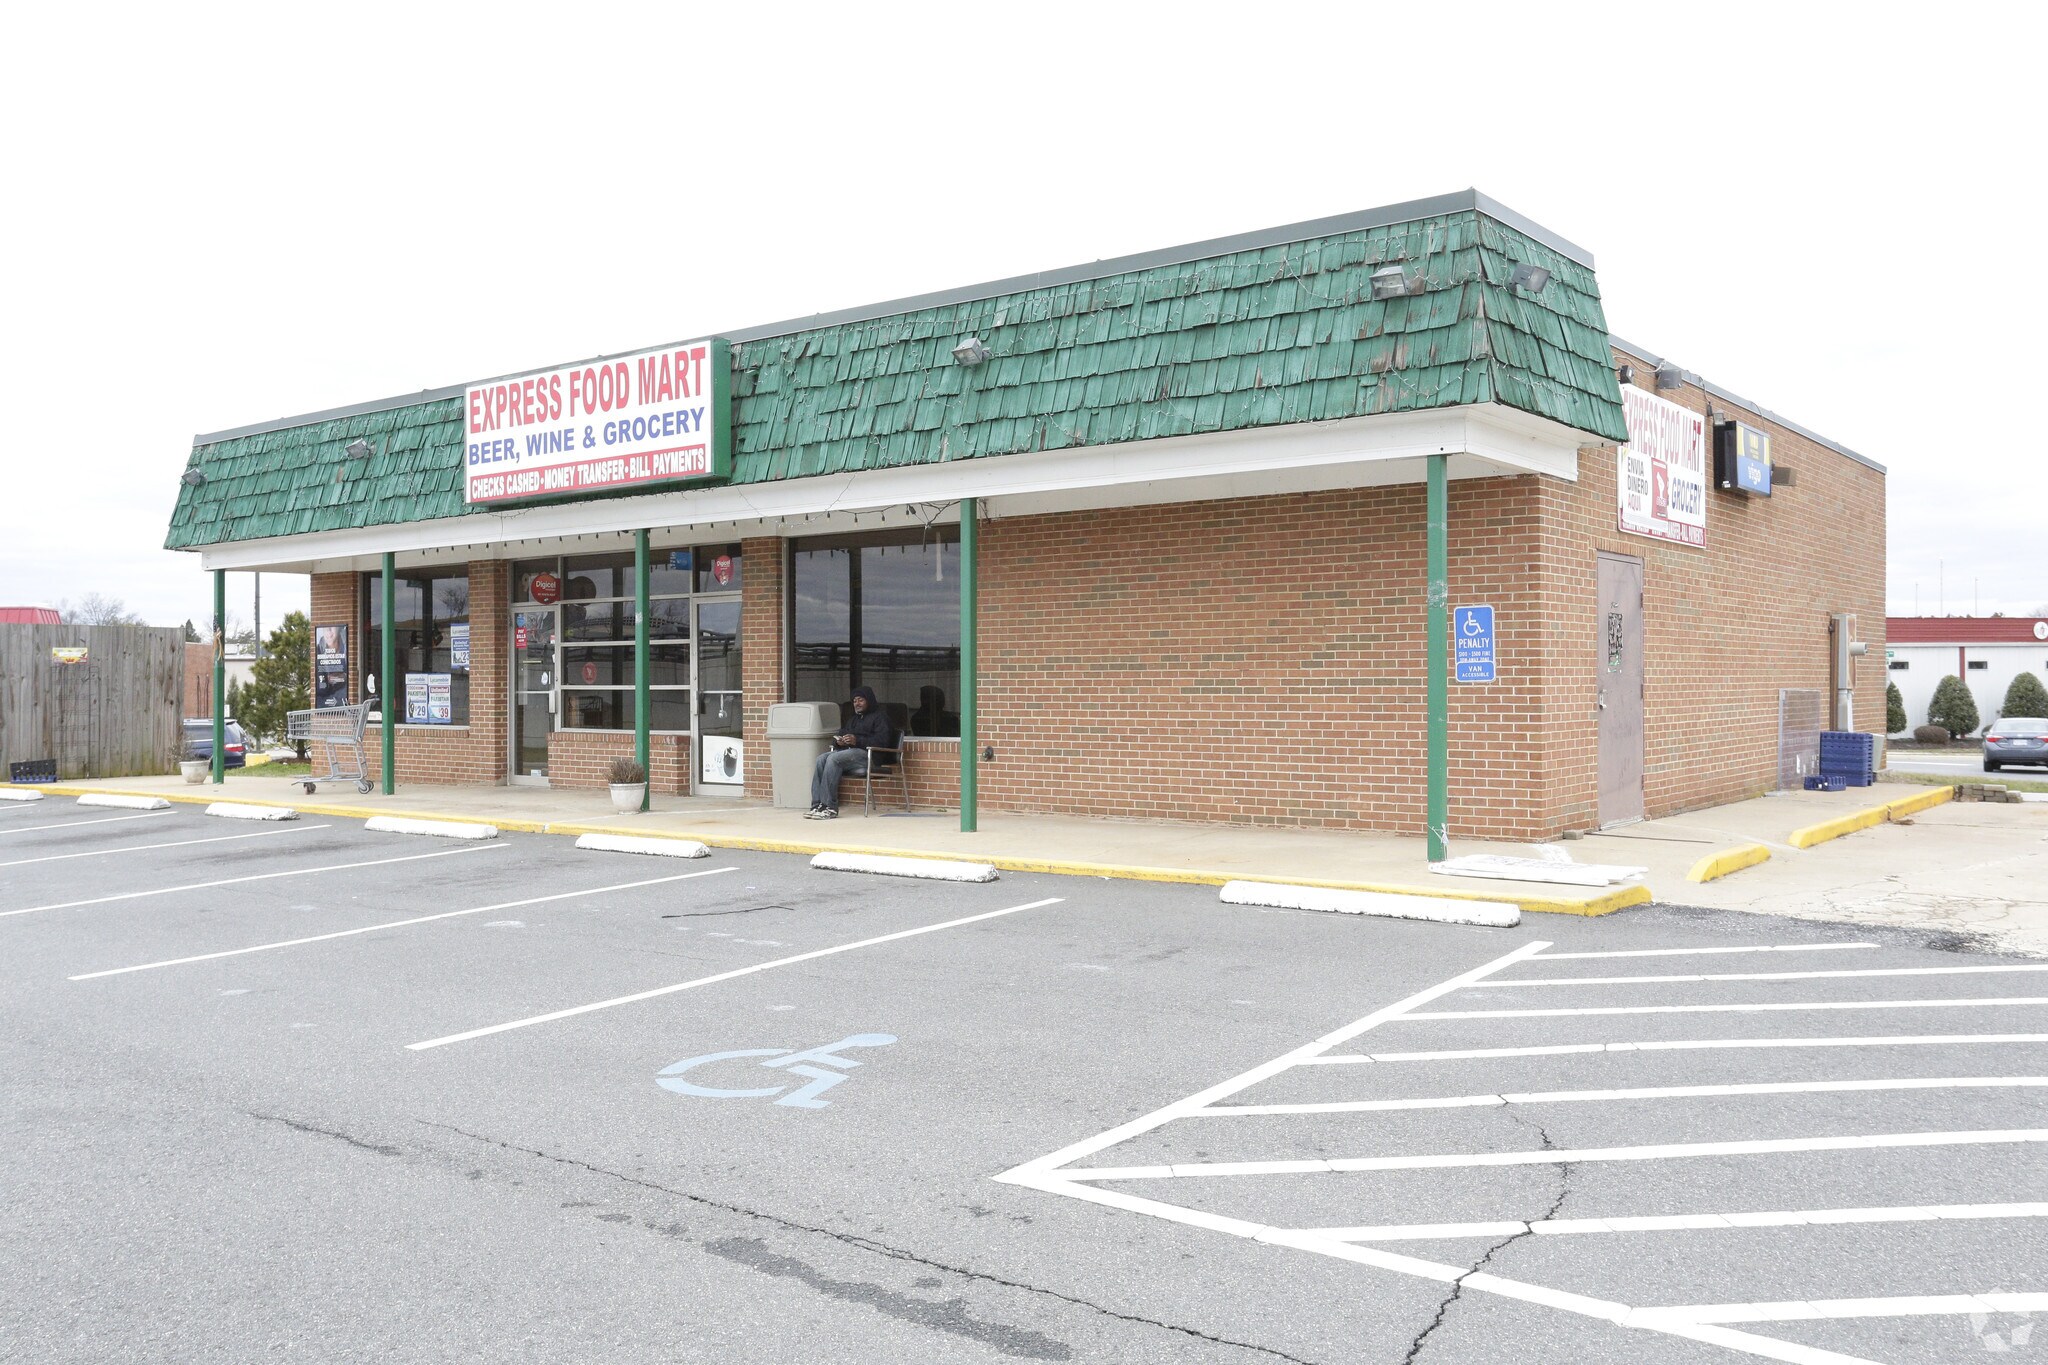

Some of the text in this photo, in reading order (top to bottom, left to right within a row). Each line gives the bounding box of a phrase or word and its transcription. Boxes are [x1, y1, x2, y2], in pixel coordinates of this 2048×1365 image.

[470, 346, 706, 434] EXPRESS FOOD MART
[469, 407, 705, 465] BEER, WINE & GROCERY
[1623, 390, 1702, 473] EXPRESS FOOD MART
[472, 448, 705, 499] CHECKS CASHED MONEY TRANSFER BILL PAYMENTS
[1628, 456, 1644, 476] ENVIA
[1628, 474, 1648, 496] DINERO
[1672, 476, 1702, 516] GROCERY
[716, 560, 730, 568] Digicel
[536, 581, 556, 589] Digicel
[1459, 638, 1489, 648] PENALTY
